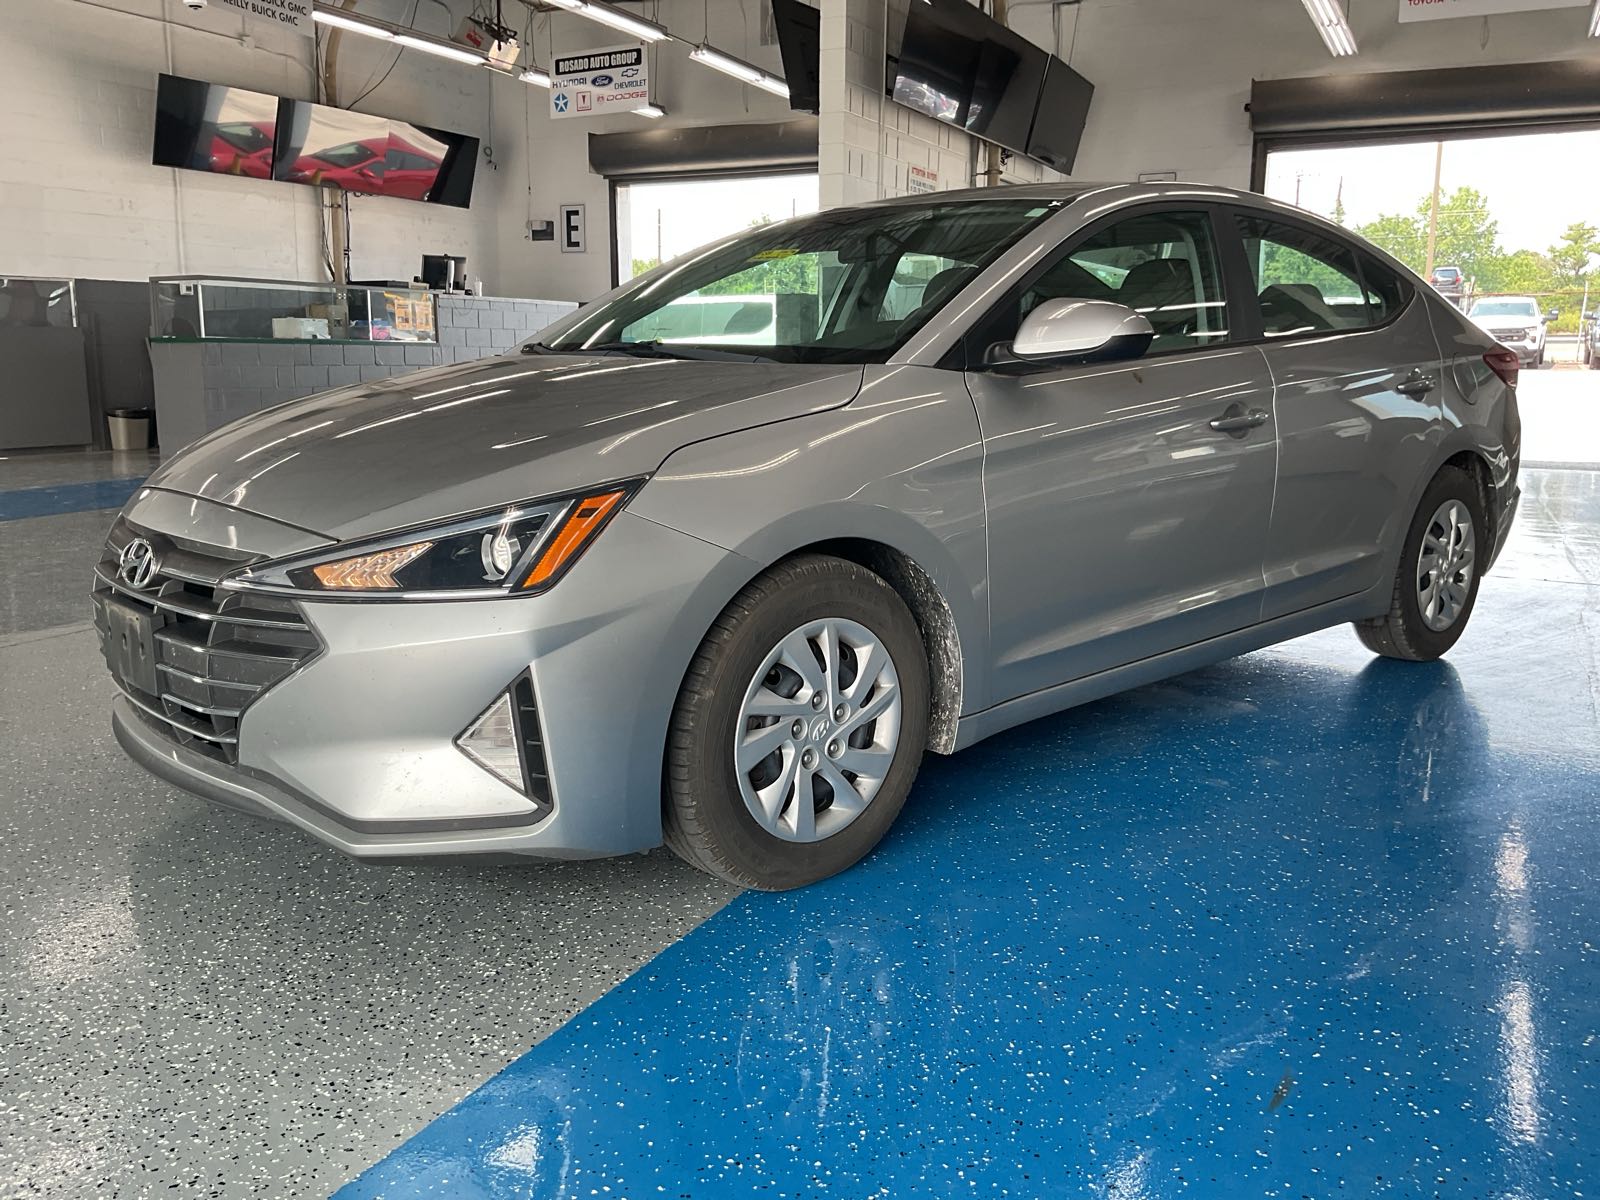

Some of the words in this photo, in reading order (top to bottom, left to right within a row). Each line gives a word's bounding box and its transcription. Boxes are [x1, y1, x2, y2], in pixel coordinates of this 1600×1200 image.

[251, 2, 277, 19] BUICK
[279, 12, 299, 26] GMC
[261, 0, 286, 9] ICK
[287, 2, 307, 16] GMC
[559, 57, 589, 73] ROSADO
[590, 54, 610, 69] AUTO
[611, 51, 637, 66] GROUP
[552, 77, 587, 89] HYUNDAI
[614, 78, 647, 90] CHEVROLET
[607, 91, 647, 102] DODGE
[566, 210, 580, 247] E
